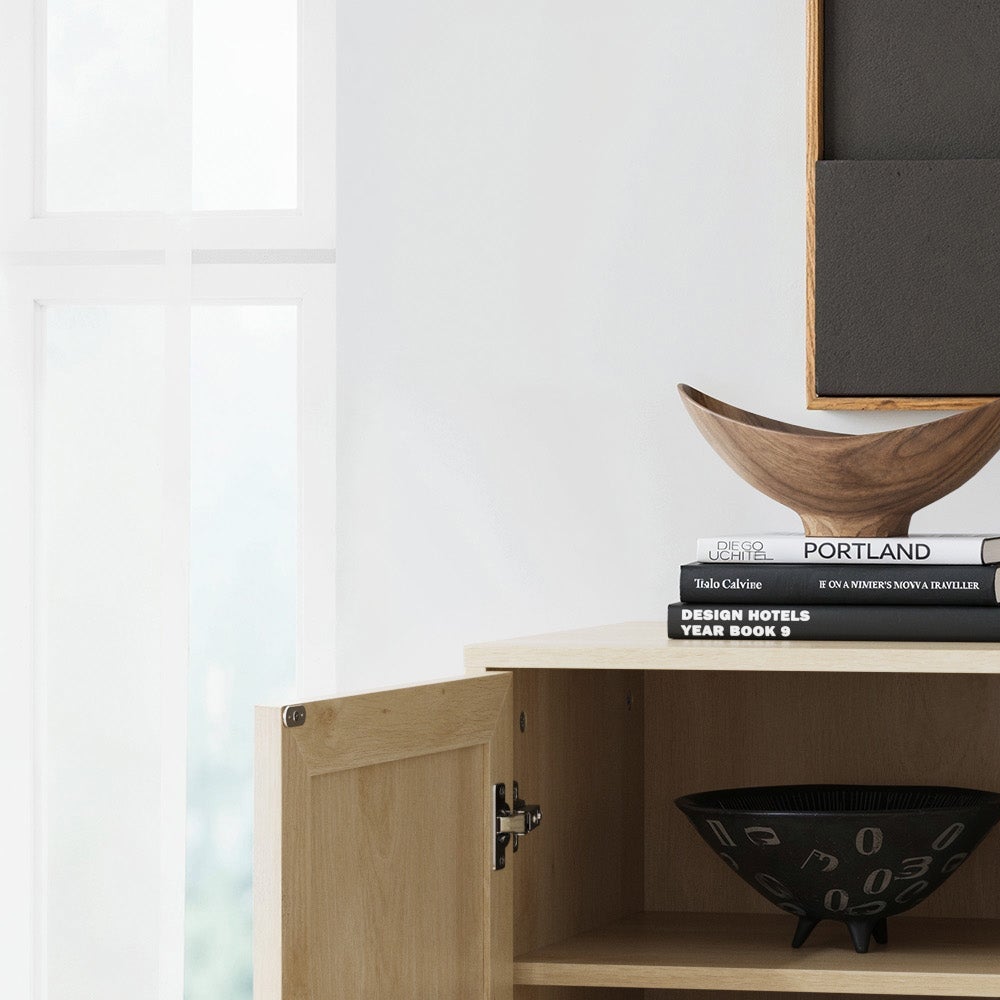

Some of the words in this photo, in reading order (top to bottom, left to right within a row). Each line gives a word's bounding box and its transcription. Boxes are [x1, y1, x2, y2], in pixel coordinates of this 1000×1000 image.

[717, 541, 764, 551] DIEGO
[804, 542, 931, 560] PORTLAND
[681, 609, 743, 621] DESIGN
[748, 609, 811, 622] HOTELS
[680, 624, 725, 636] YEAR
[729, 625, 777, 637] BOOK
[780, 625, 791, 637] 9
